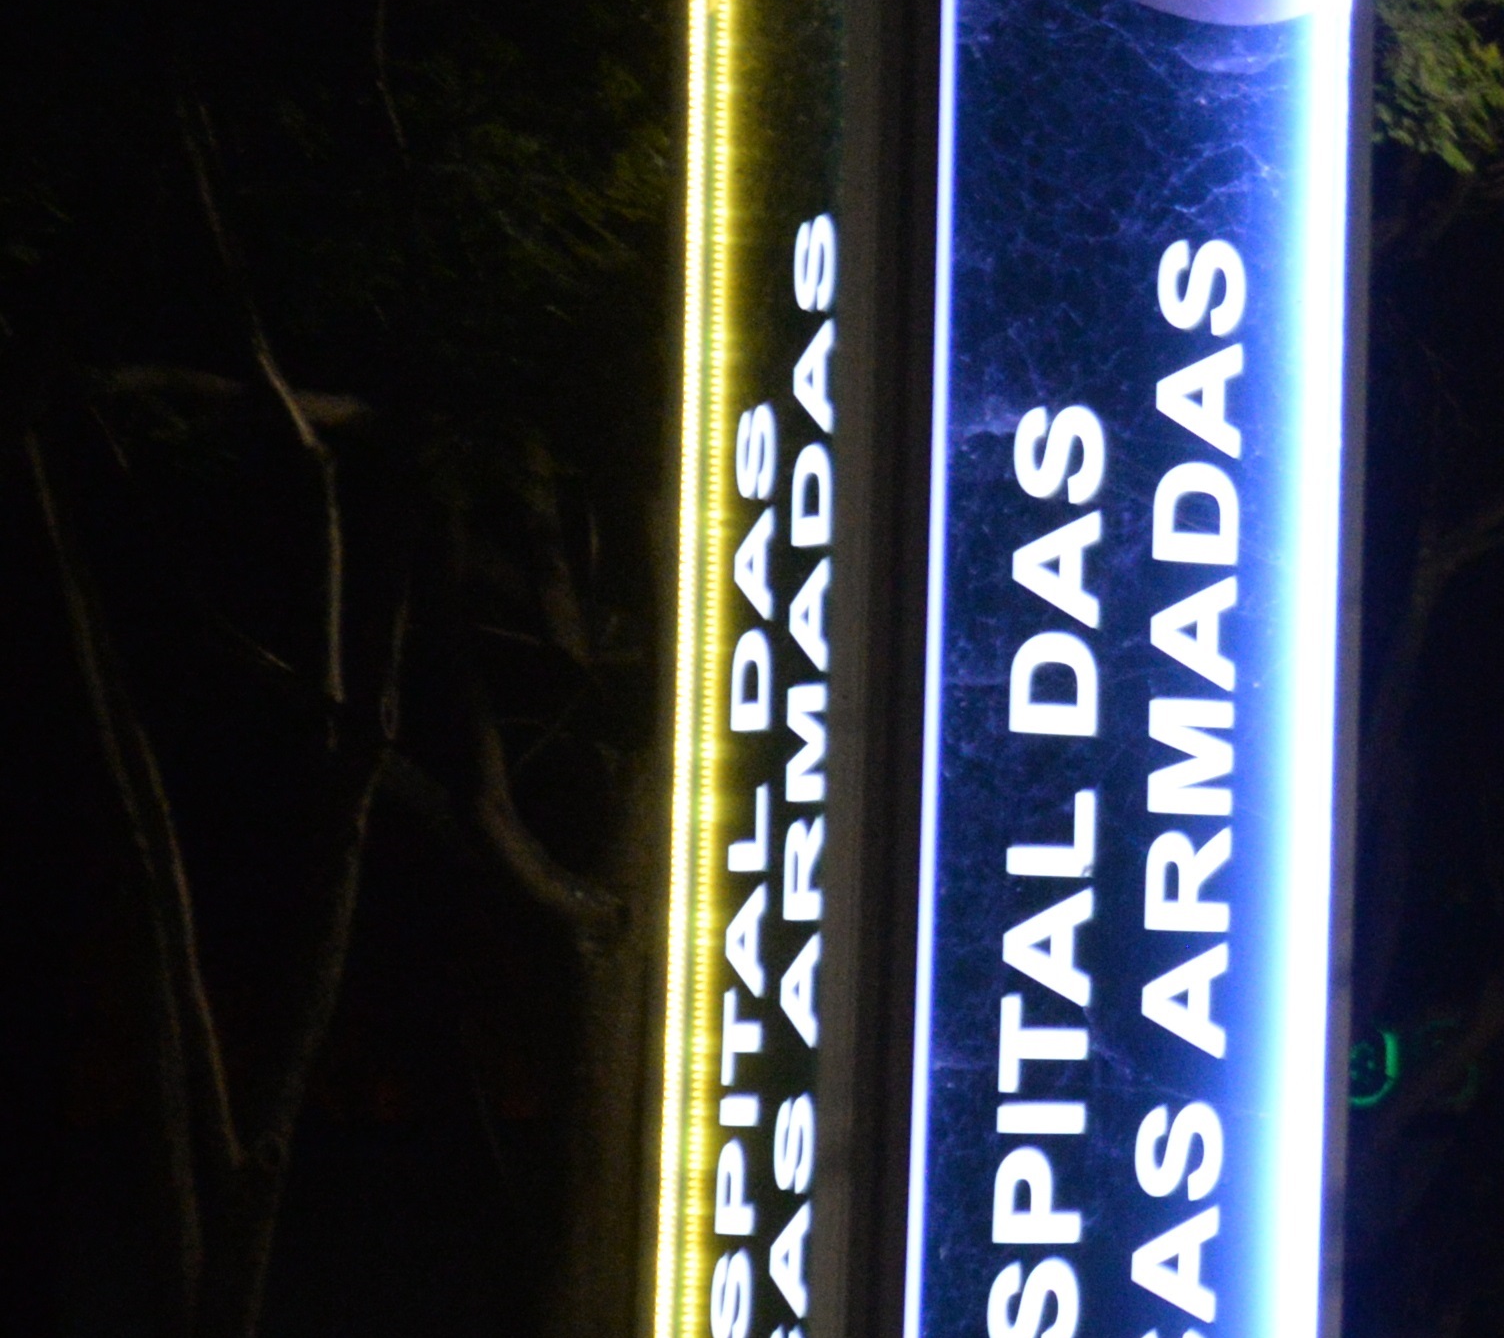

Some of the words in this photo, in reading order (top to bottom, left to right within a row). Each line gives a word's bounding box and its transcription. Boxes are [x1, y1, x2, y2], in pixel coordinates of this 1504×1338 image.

[730, 402, 777, 735] DAS
[779, 212, 838, 1049] ARMADAS
[1008, 403, 1106, 738] DAS
[1141, 238, 1247, 1060] ARMADAS
